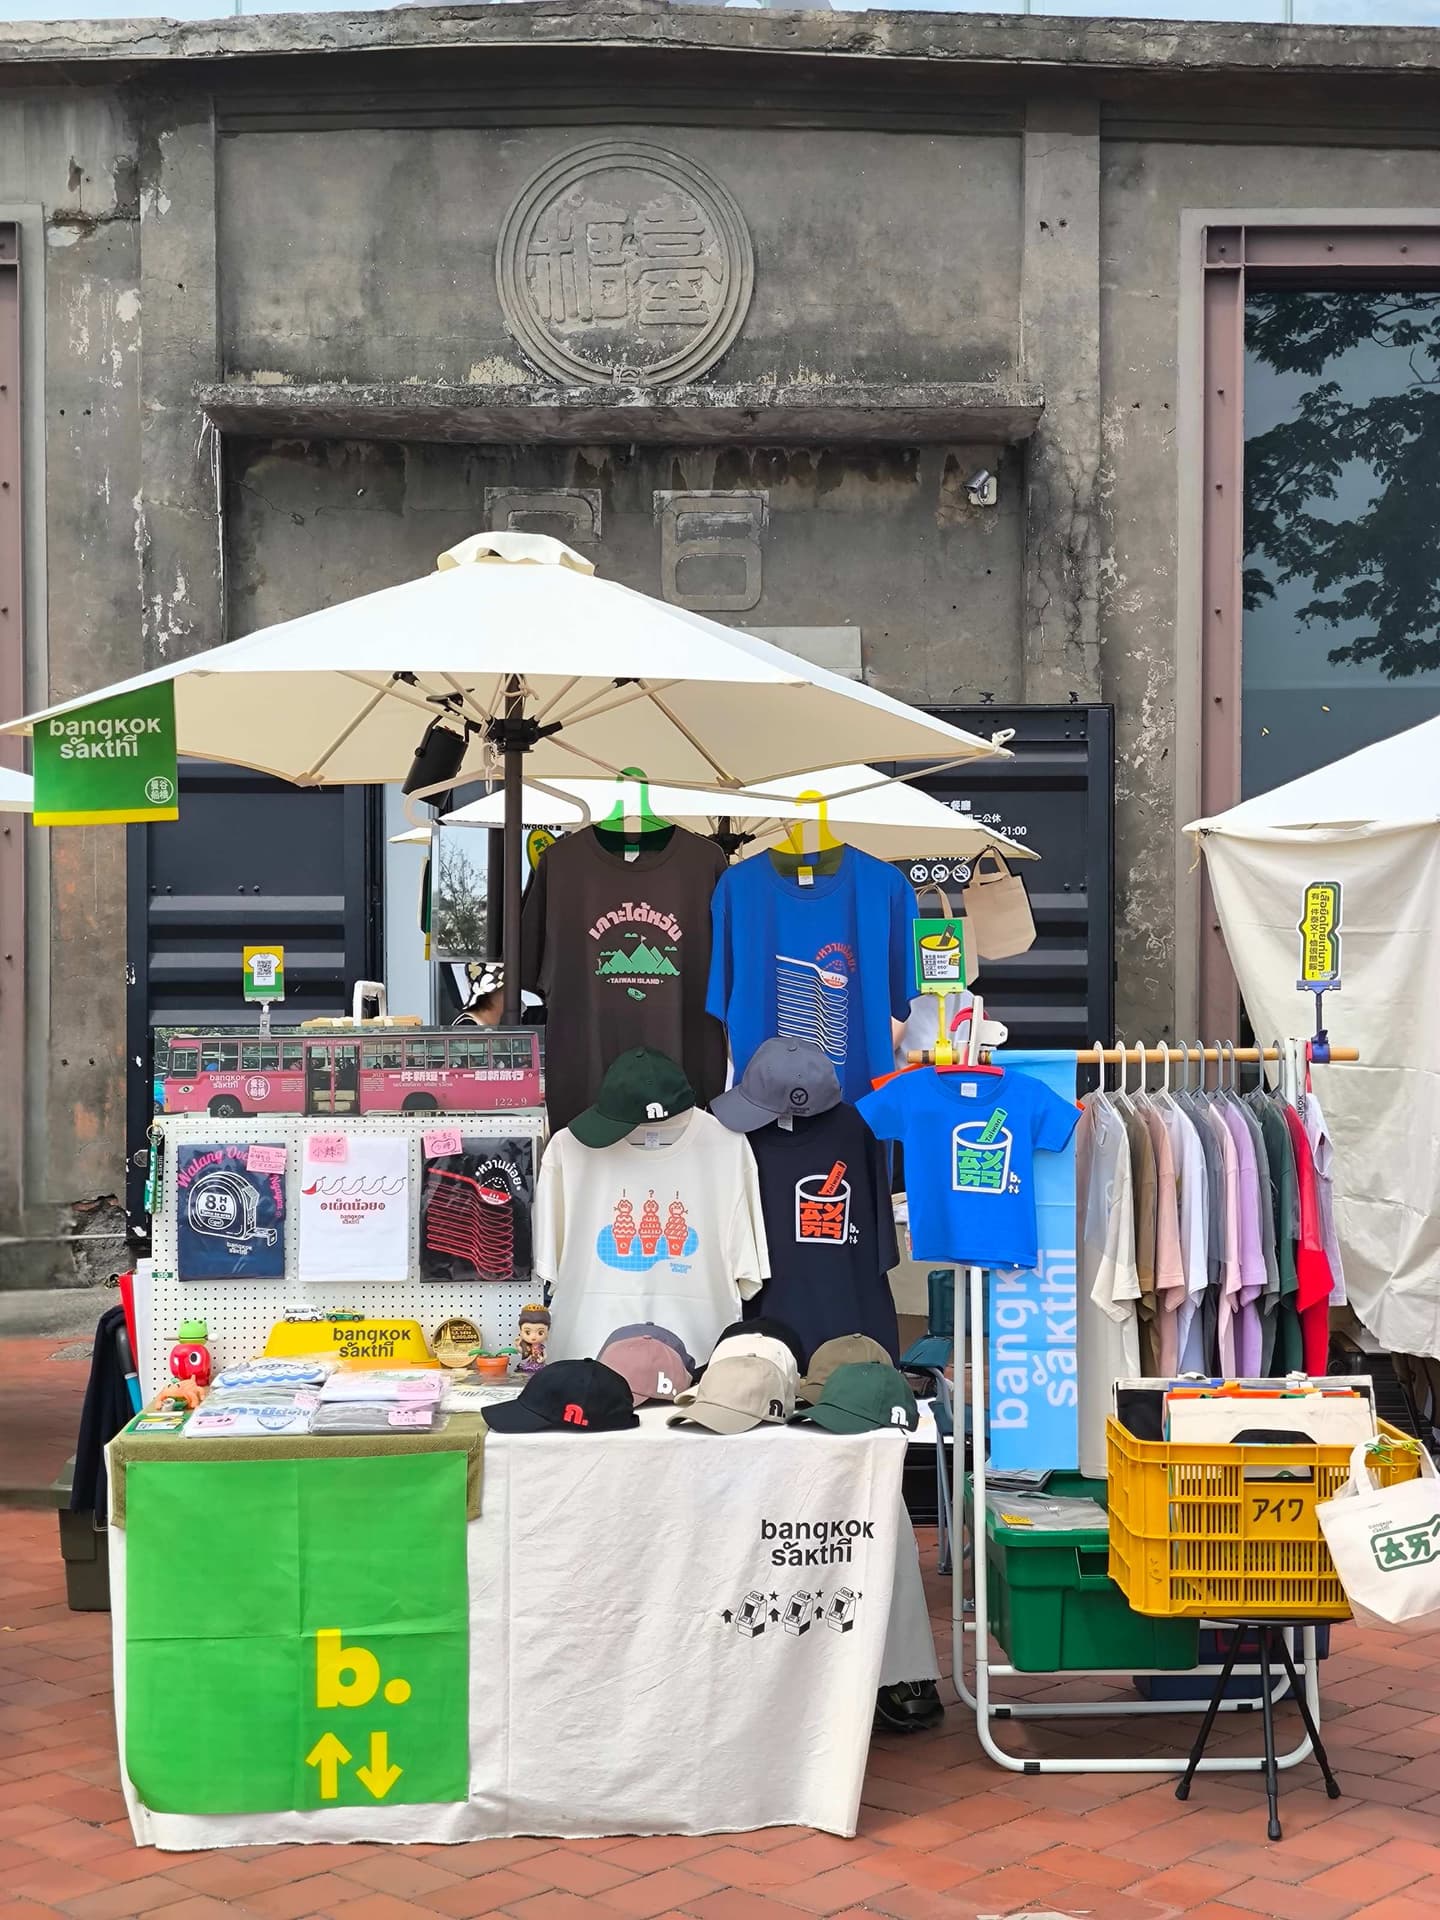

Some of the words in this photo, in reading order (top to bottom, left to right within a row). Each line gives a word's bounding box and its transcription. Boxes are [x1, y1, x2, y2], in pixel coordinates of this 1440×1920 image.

[1251, 1498, 1305, 1523] アイワ
[316, 1628, 412, 1709] b.
